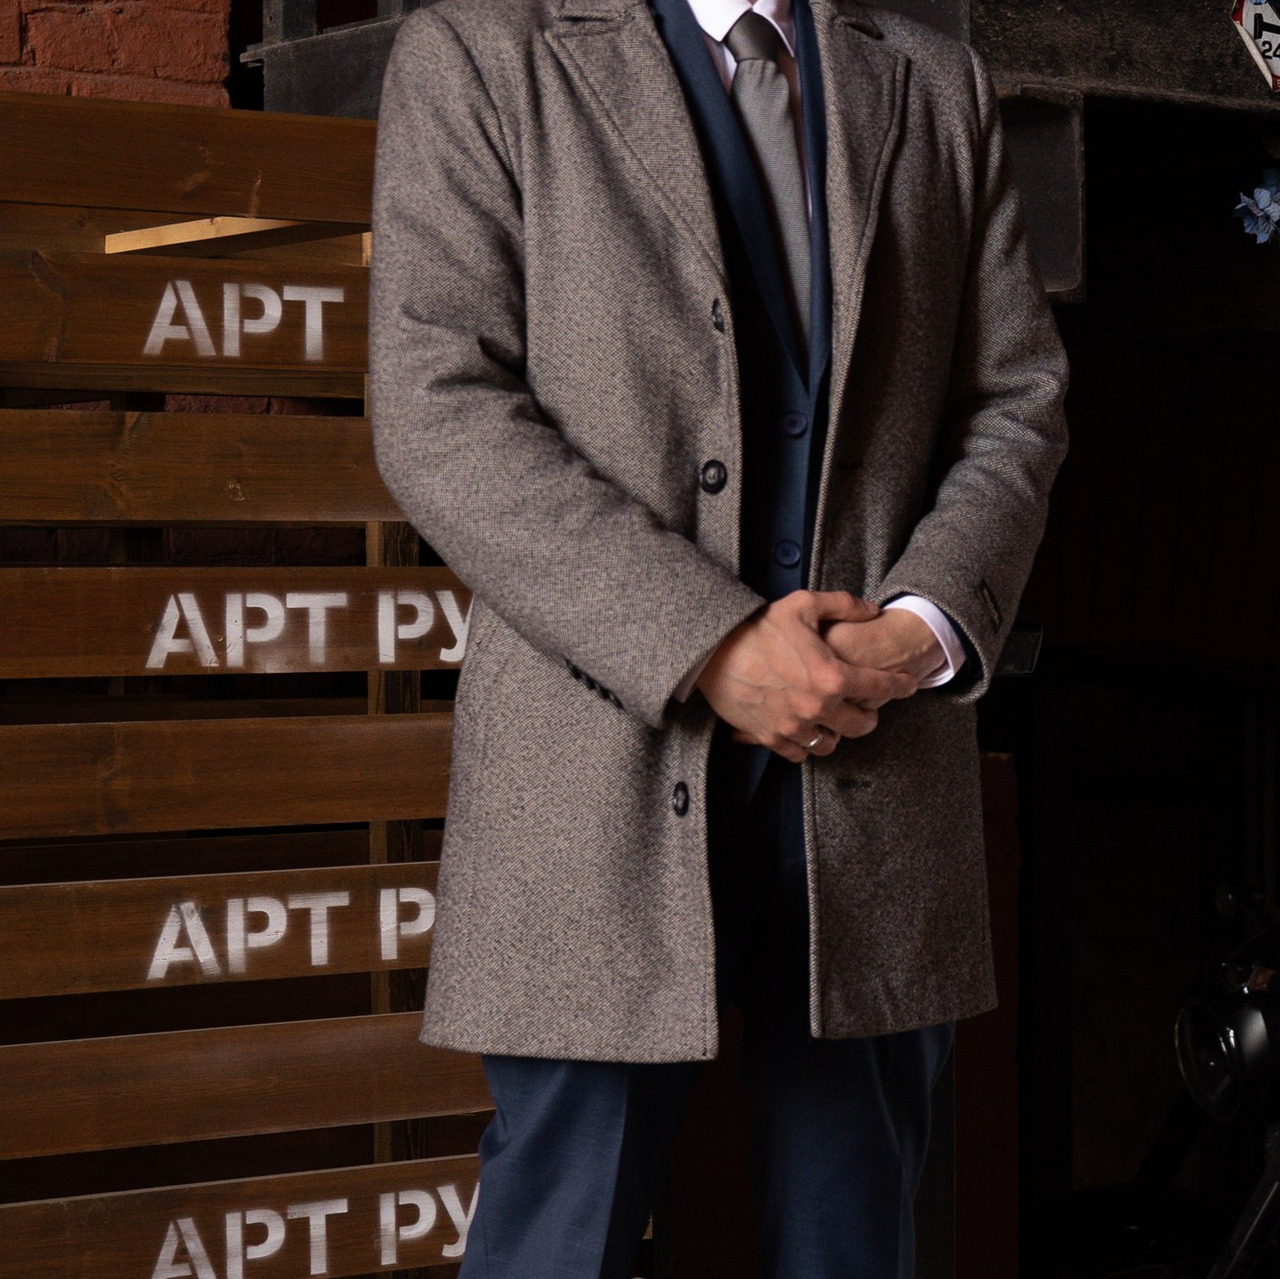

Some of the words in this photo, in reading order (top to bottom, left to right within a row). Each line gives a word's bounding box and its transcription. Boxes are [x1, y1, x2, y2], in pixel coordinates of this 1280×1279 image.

[142, 280, 345, 361] АРТ
[145, 590, 348, 669] АРТ
[377, 588, 474, 664] РУ
[145, 891, 350, 981] АРТ
[379, 886, 436, 961] Р
[379, 1181, 480, 1266] РУ
